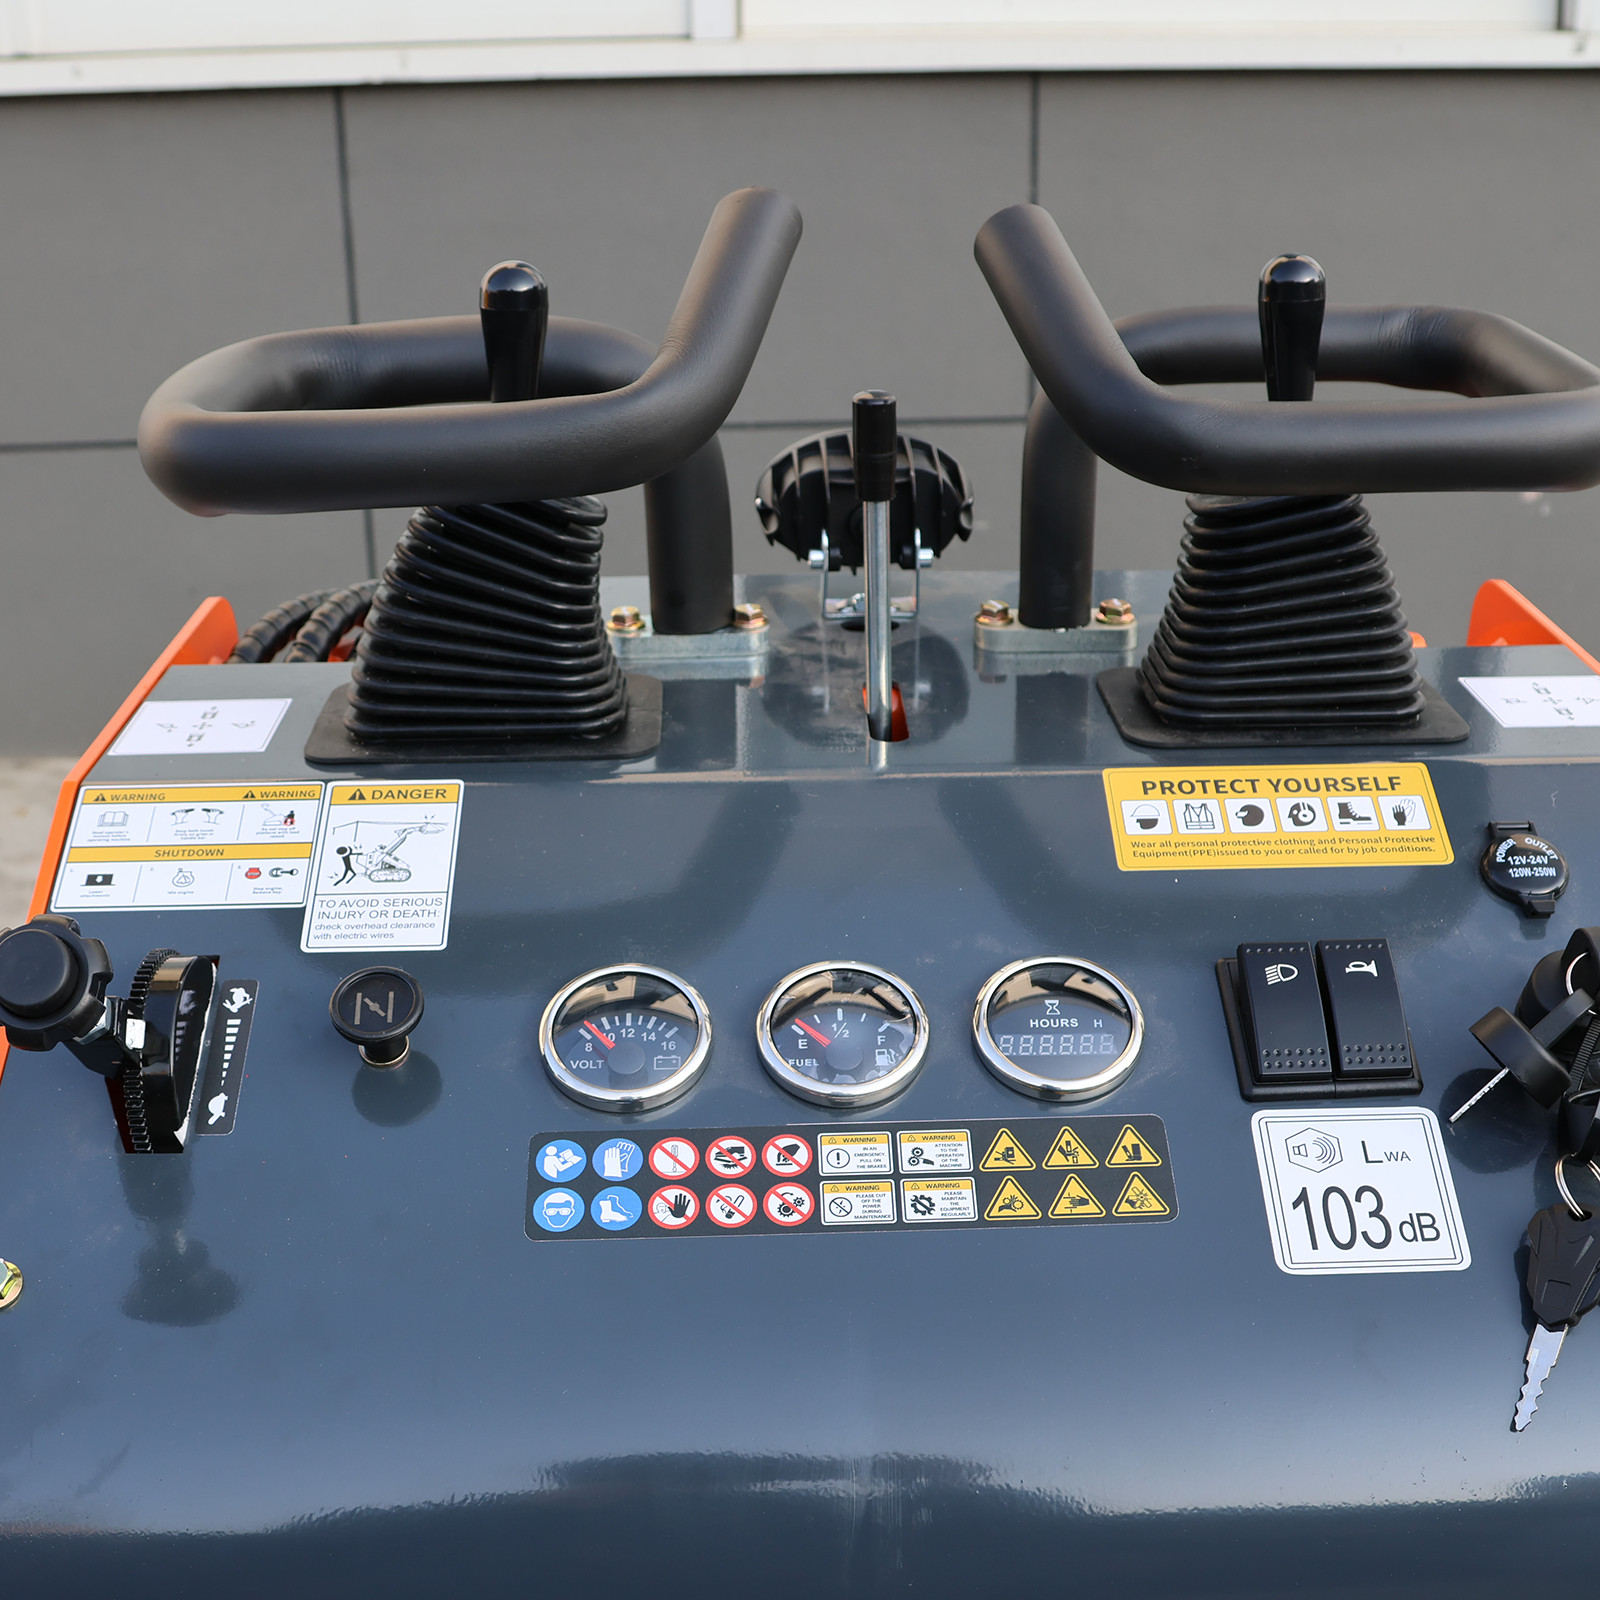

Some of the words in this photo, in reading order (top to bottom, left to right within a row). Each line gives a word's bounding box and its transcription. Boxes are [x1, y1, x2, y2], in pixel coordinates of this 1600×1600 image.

[1141, 778, 1260, 795] PROTECT
[1267, 776, 1402, 793] YOURSELF
[110, 793, 166, 801] WARNING
[260, 790, 316, 798] WARNING
[371, 788, 447, 800] DANGER
[1174, 840, 1218, 849] personal
[1221, 839, 1272, 848] protective
[1274, 838, 1315, 846] clothing
[154, 848, 224, 858] SHUTDOWN
[1348, 846, 1359, 854] by
[1361, 846, 1378, 854] job
[1380, 845, 1436, 853] conditions.
[1496, 838, 1517, 862] POWER
[1524, 838, 1558, 860] OUTLET
[1508, 855, 1548, 865] 12V-24V
[1509, 867, 1556, 878] 120W-250W
[319, 900, 336, 908] TO
[339, 899, 379, 908] AVOID
[383, 898, 443, 907] SERIOUS
[318, 910, 365, 920] INJURY
[369, 910, 388, 919] OR
[393, 910, 440, 918] DEATH:
[1030, 1018, 1079, 1028] HOURS
[1094, 1019, 1103, 1028] H
[620, 1028, 635, 1038] 12
[832, 1022, 850, 1038] 1/2
[604, 1032, 616, 1042] 0
[641, 1032, 656, 1042] 14
[877, 1036, 886, 1045] F
[585, 1043, 592, 1052] 8
[661, 1041, 676, 1051] 16
[798, 1039, 808, 1049] E
[570, 1060, 604, 1069] VOLT
[789, 1059, 819, 1067] FUEL
[1292, 1185, 1392, 1251] 103
[1399, 1212, 1440, 1242] dB
